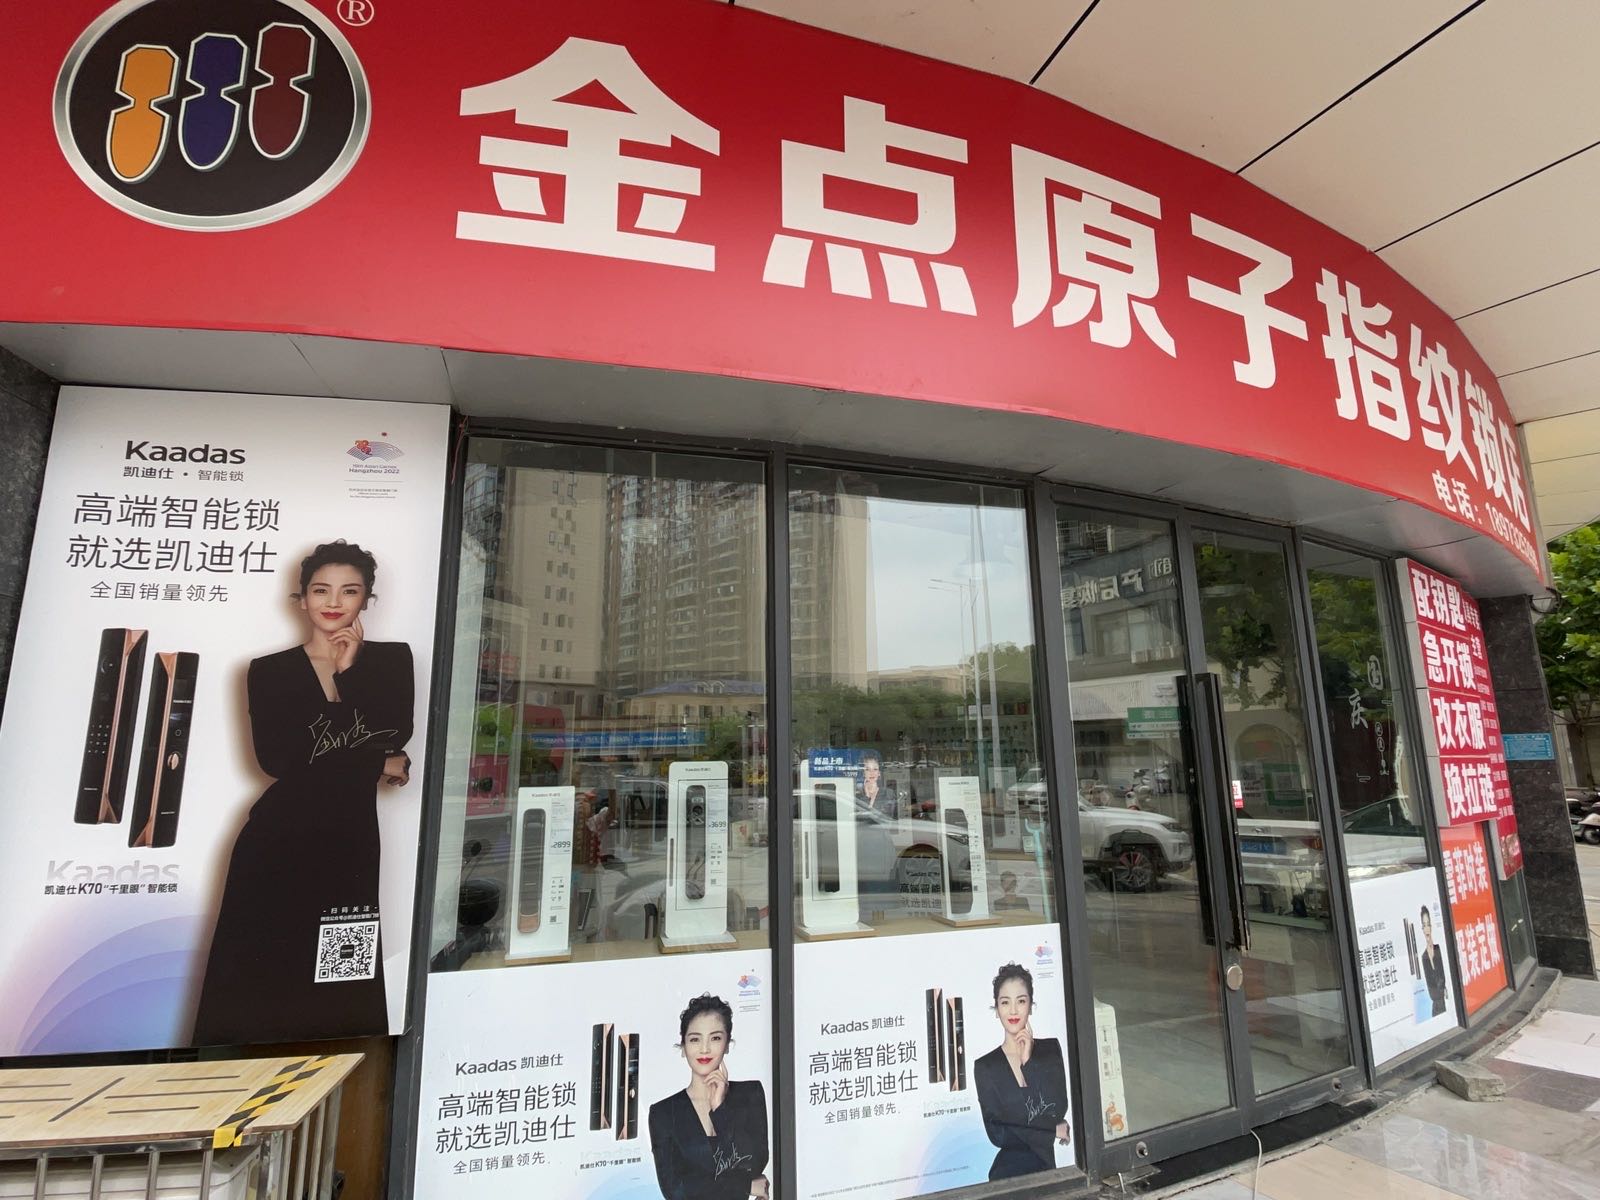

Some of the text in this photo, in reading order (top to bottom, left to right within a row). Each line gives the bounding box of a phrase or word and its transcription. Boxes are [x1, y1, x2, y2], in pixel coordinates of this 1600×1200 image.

[456, 36, 1532, 533] 金点原子指纹锁店
[125, 440, 246, 465] Kaadas
[73, 492, 280, 532] 高端智能锁
[65, 534, 278, 575] 就选凯迪仕
[90, 581, 229, 603] 全国销量领先
[1410, 568, 1466, 631] 配钥匙
[1423, 630, 1476, 690] 急开锁
[1433, 697, 1486, 750] 改衣服
[1443, 762, 1497, 819] 换拉链
[820, 1015, 905, 1036] Kaadas 凯迪仕
[455, 1053, 564, 1076] Kaadas 凯迪仕
[808, 1040, 918, 1077] 高端智能锁
[437, 1081, 577, 1121] 高端智能锁
[808, 1069, 919, 1107] 就选凯迪仕
[435, 1114, 576, 1154] 就选凯迪仕
